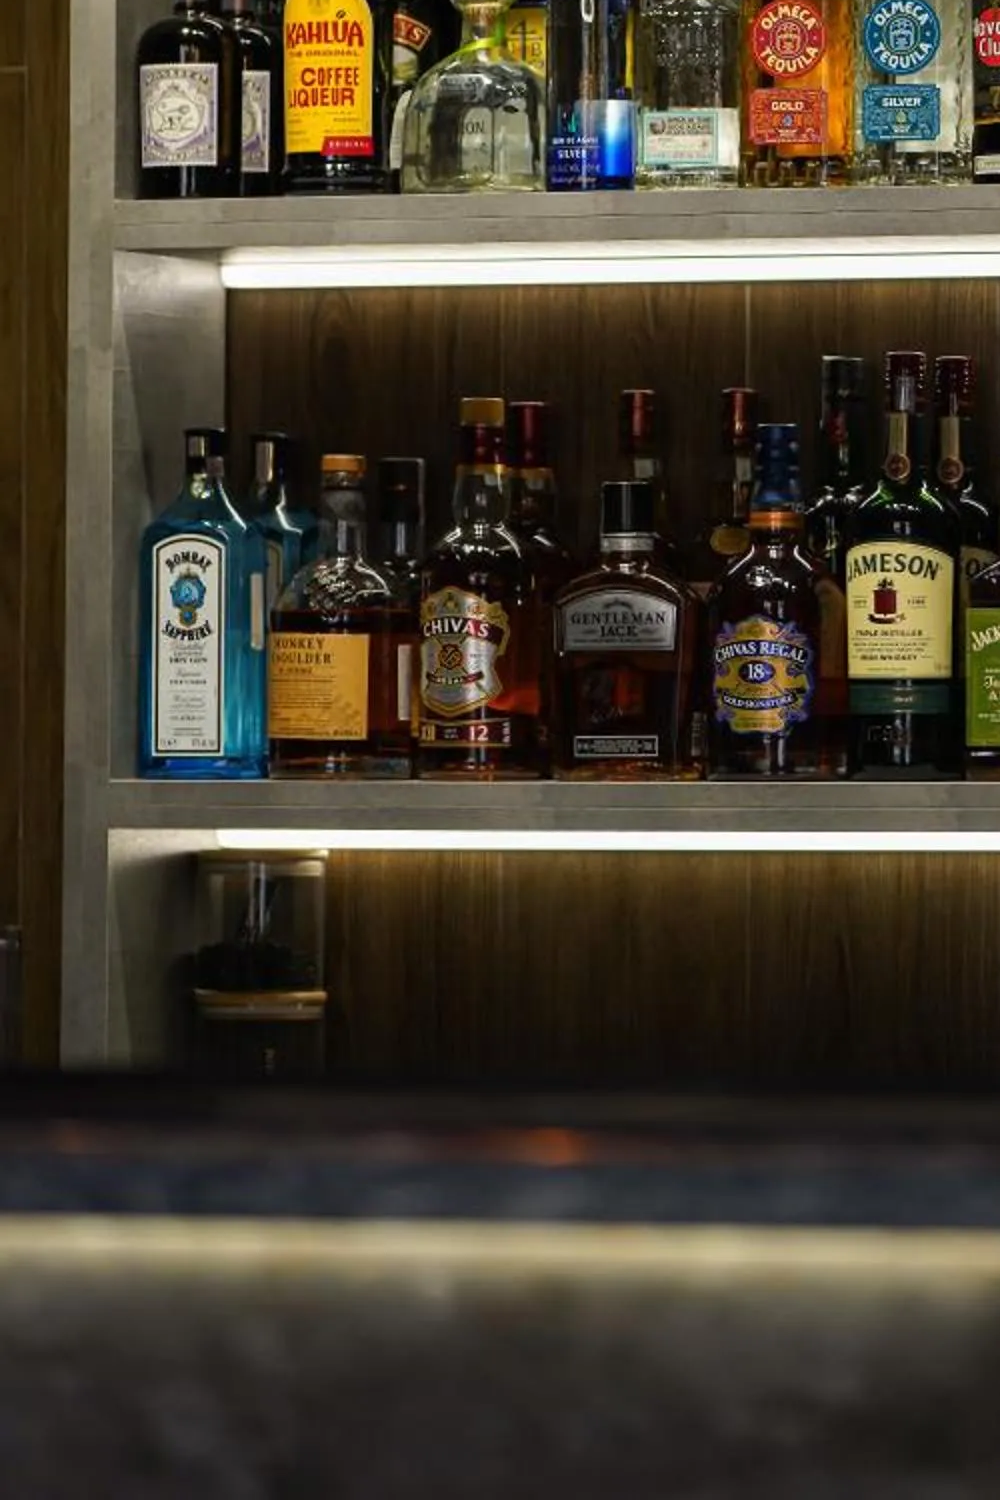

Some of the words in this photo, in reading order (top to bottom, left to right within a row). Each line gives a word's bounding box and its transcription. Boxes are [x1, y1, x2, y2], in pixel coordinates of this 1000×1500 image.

[761, 4, 818, 31] OLMECA
[872, 1, 931, 27] OLMECA
[759, 45, 820, 74] TEQUILA
[872, 42, 933, 71] TEQUILA
[301, 66, 360, 87] COFFEE
[771, 100, 805, 112] GOLD
[881, 96, 923, 108] SILVER
[165, 550, 214, 574] BOMBAY
[847, 552, 941, 583] JAMESON
[423, 616, 490, 638] CHIVAS
[570, 611, 667, 626] GENTLEMAN
[162, 618, 214, 642] SAPPHIRE
[600, 626, 639, 638] JACK
[715, 641, 757, 664] CHIVAS
[759, 641, 805, 664] REGAL
[747, 662, 765, 680] 18
[468, 724, 490, 741] 12
